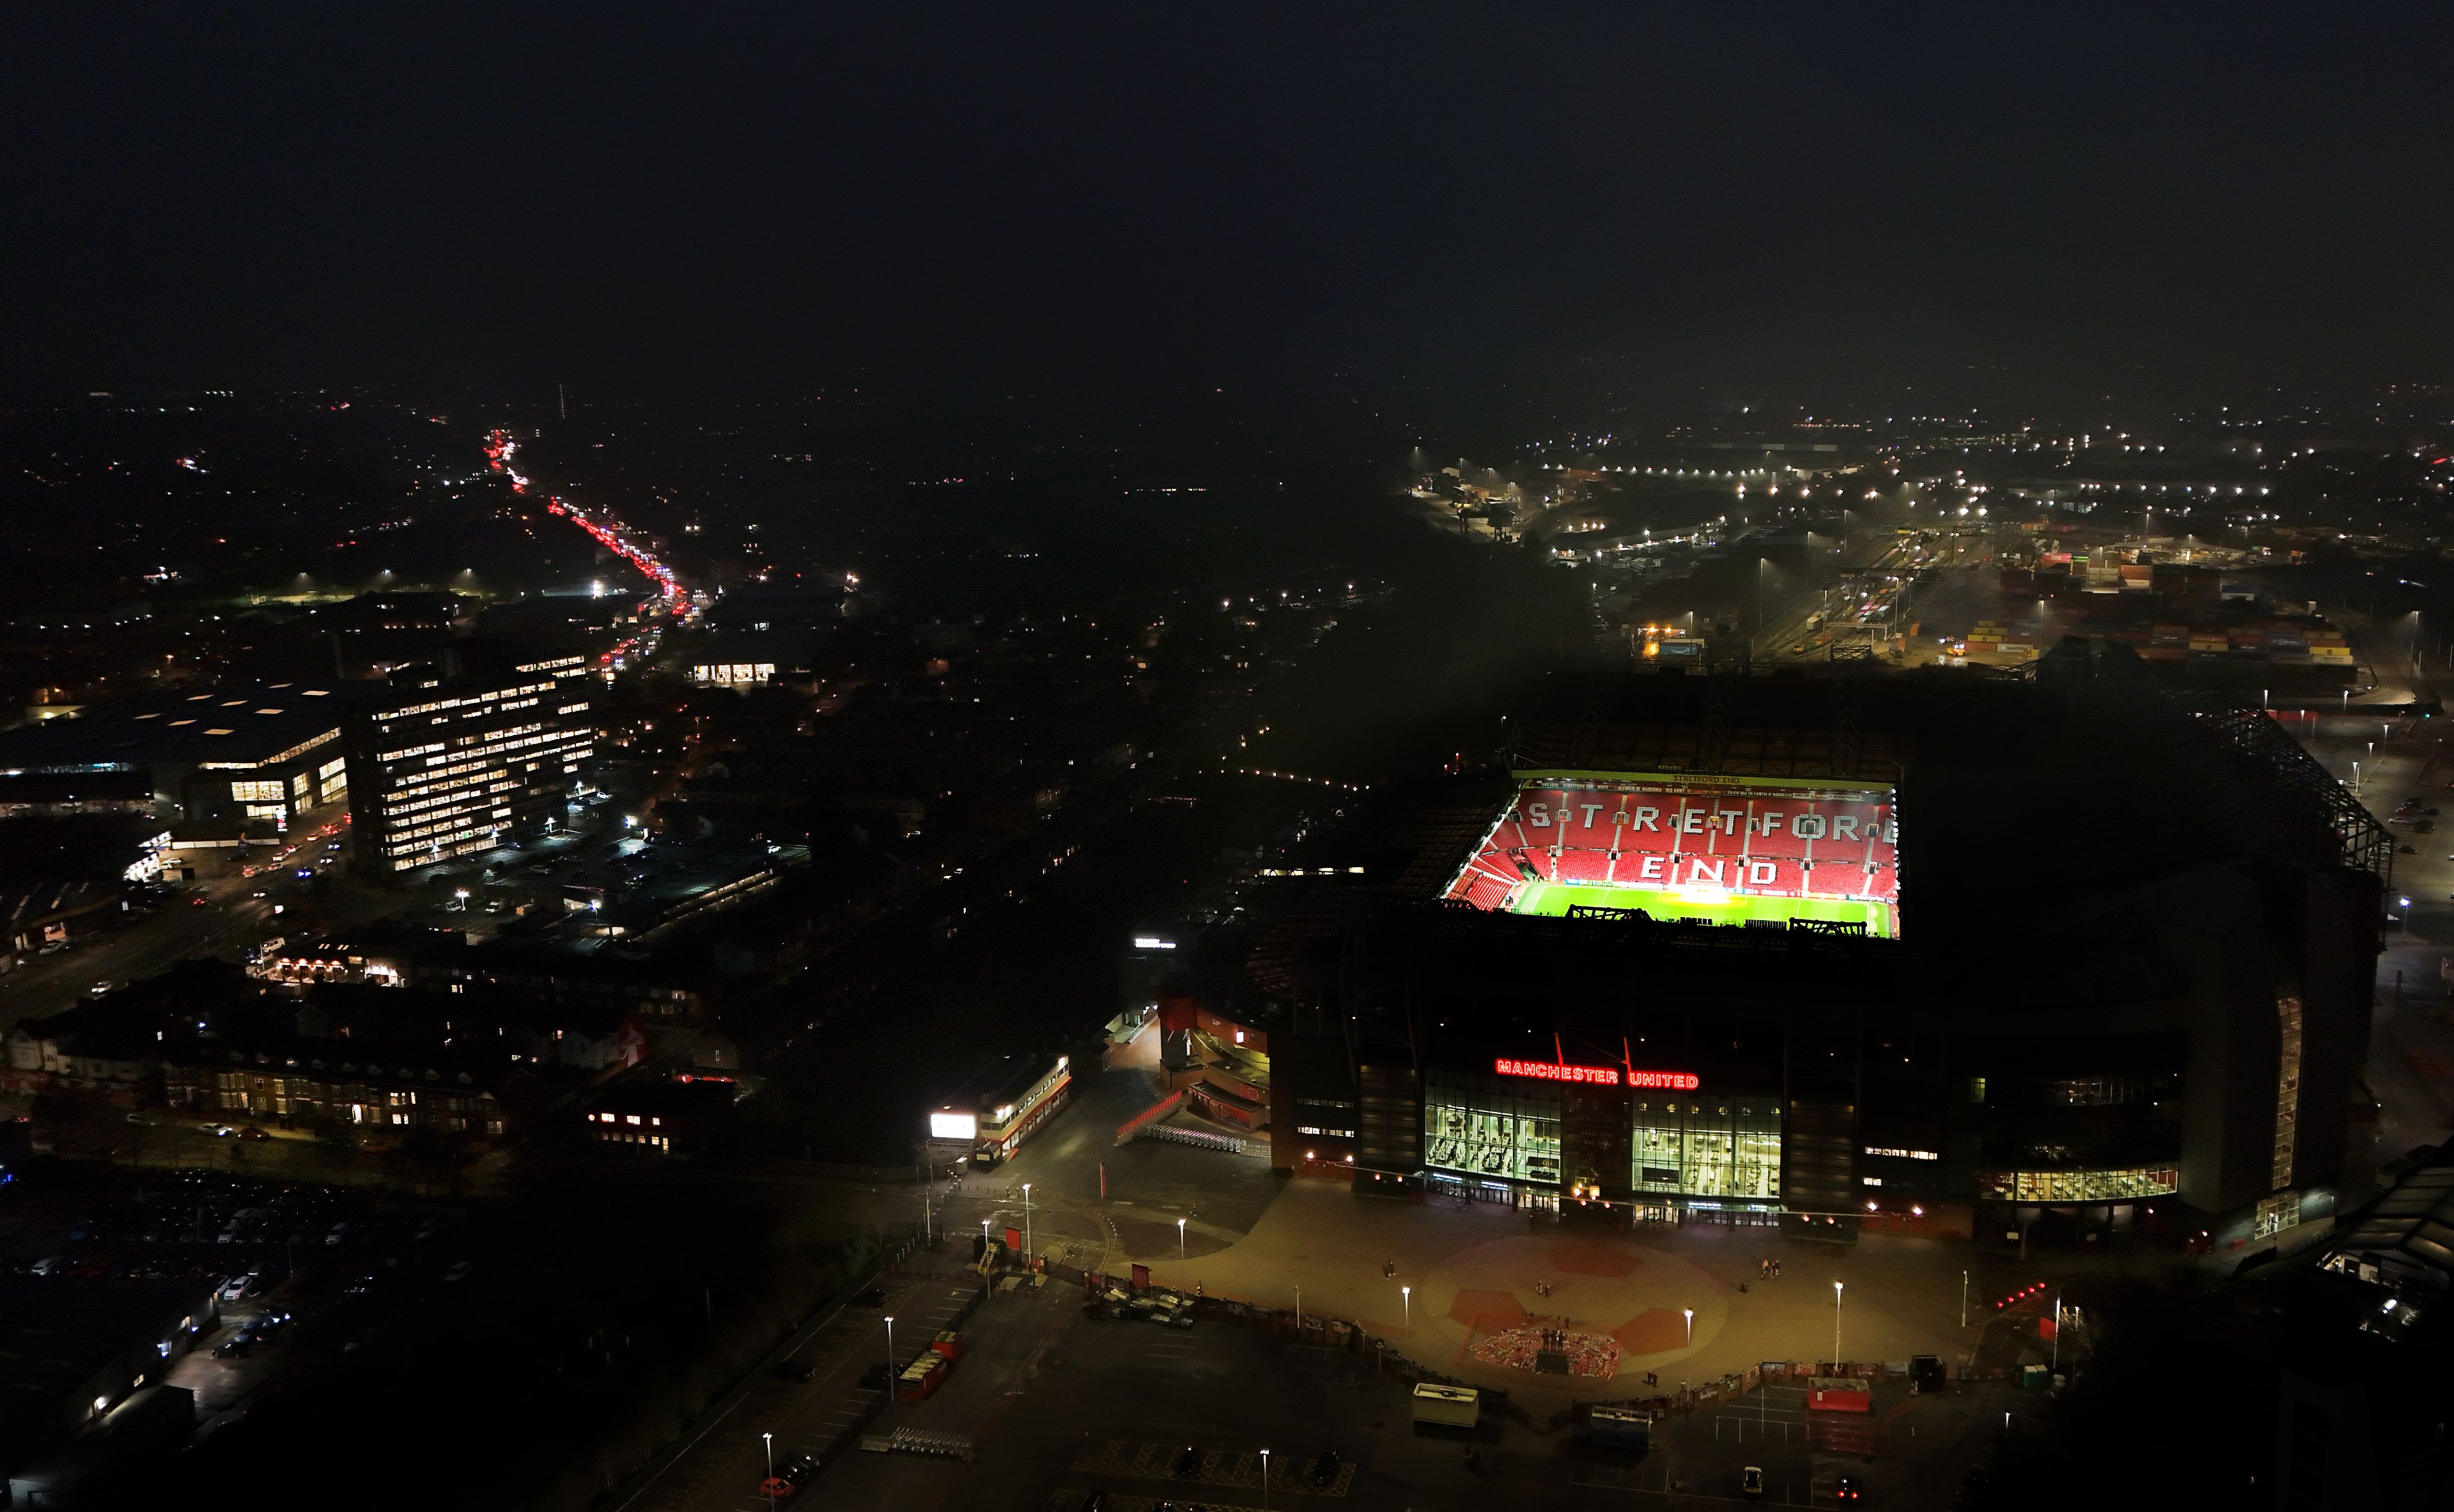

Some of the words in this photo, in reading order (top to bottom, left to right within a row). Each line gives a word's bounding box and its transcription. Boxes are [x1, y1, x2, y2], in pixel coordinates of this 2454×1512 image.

[1640, 856, 1778, 886] END
[1497, 1060, 1618, 1084] MANCHESTER
[1629, 1072, 1699, 1089] UNITED
